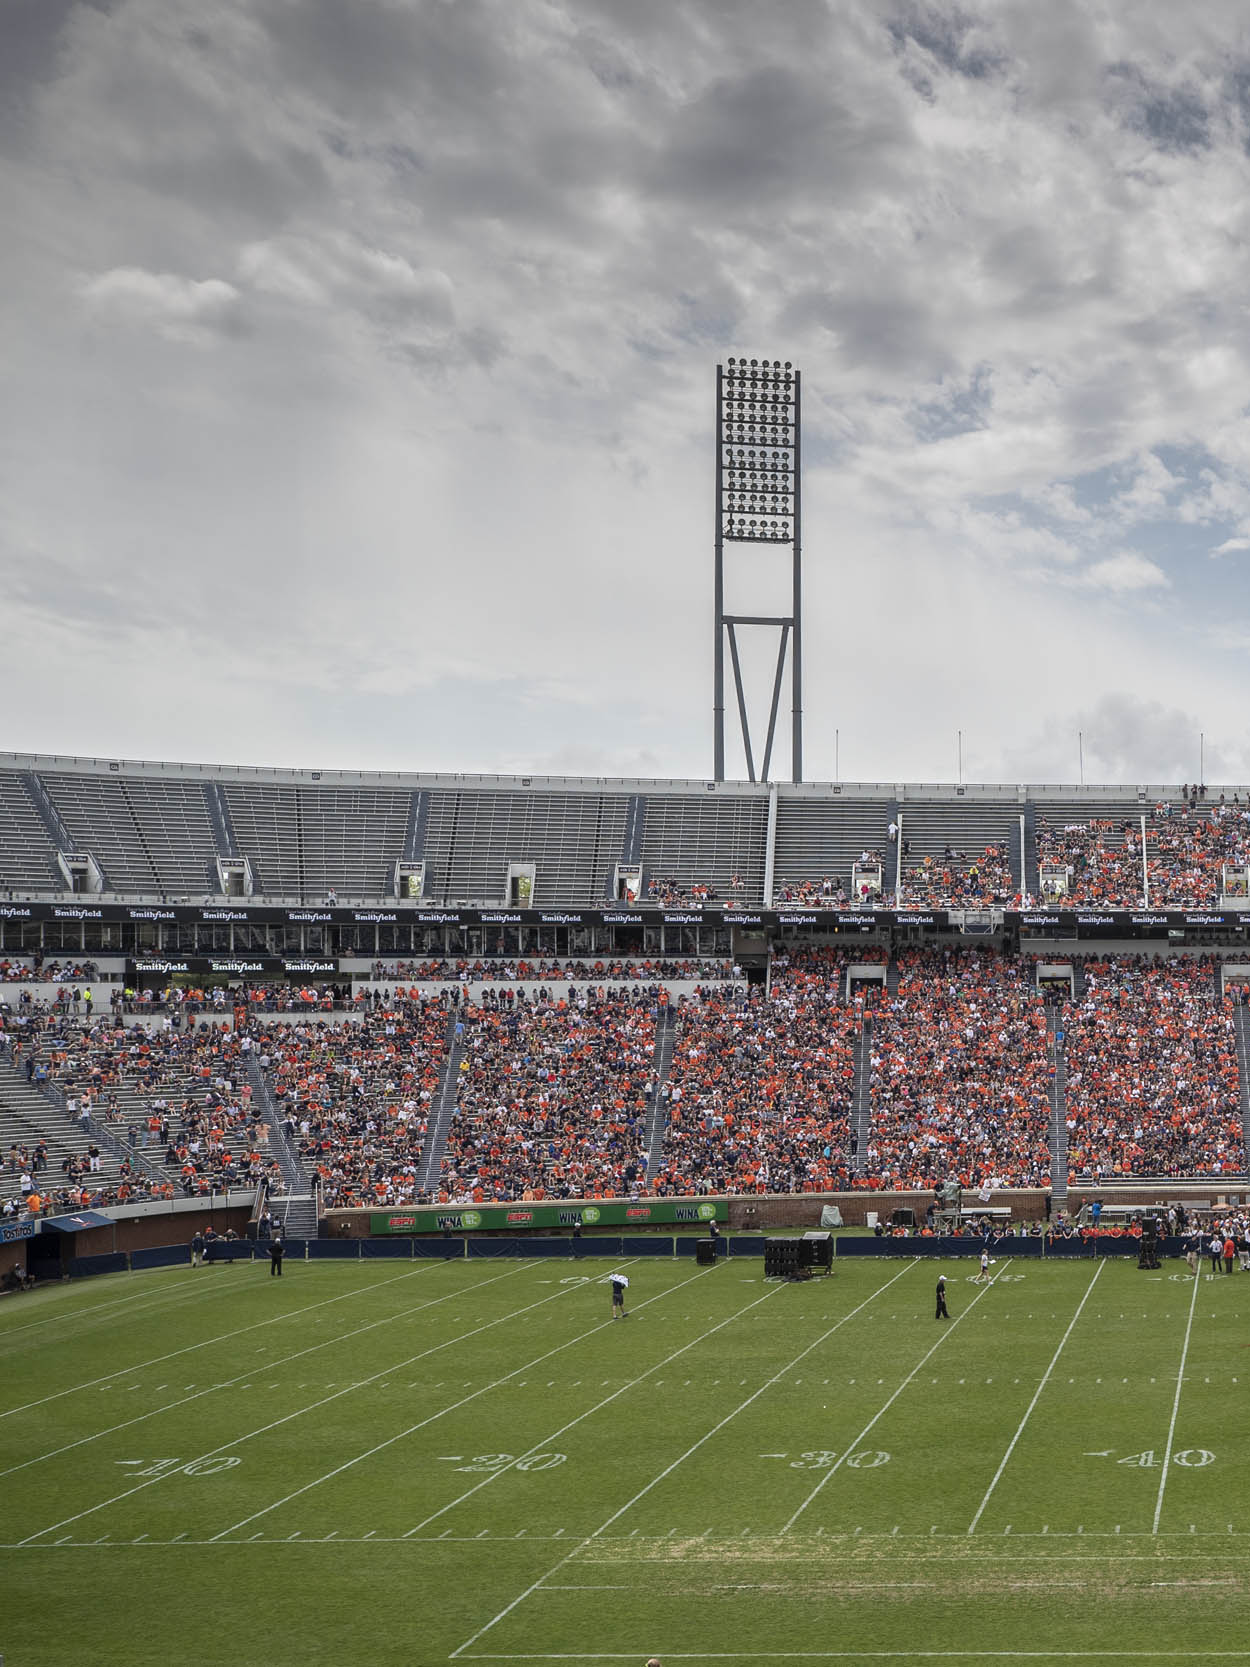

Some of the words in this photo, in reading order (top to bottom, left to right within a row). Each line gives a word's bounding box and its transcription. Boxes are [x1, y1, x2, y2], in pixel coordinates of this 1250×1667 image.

[54, 908, 102, 919] Smithfield
[129, 909, 175, 920] Smithfield
[202, 910, 247, 921] Smithfield
[288, 911, 332, 922] Smithfield
[354, 912, 397, 923] Smithfield
[417, 912, 460, 923] Smithfield
[481, 912, 521, 923] Smithfield
[541, 913, 582, 924] Smithfield
[603, 913, 642, 924] Smithfield
[663, 913, 703, 924] Smithfield
[723, 913, 761, 924] Smithfield
[779, 914, 817, 925] Smithfield
[838, 914, 876, 925] Smithfield
[894, 914, 934, 925] Smithfield
[1022, 914, 1059, 925] Smithfield
[1075, 914, 1114, 925] Smithfield
[1129, 914, 1168, 925] Smithfield
[1183, 914, 1221, 925] Smithfield
[136, 962, 188, 974] Smithfield
[212, 962, 264, 974] Smithfield
[285, 962, 335, 974] Smithfield
[560, 1212, 582, 1224] WINA
[676, 1208, 699, 1219] WINA
[452, 1453, 568, 1472] 20
[790, 1450, 891, 1469] 30
[1116, 1449, 1217, 1468] 40
[124, 1457, 242, 1477] 10
